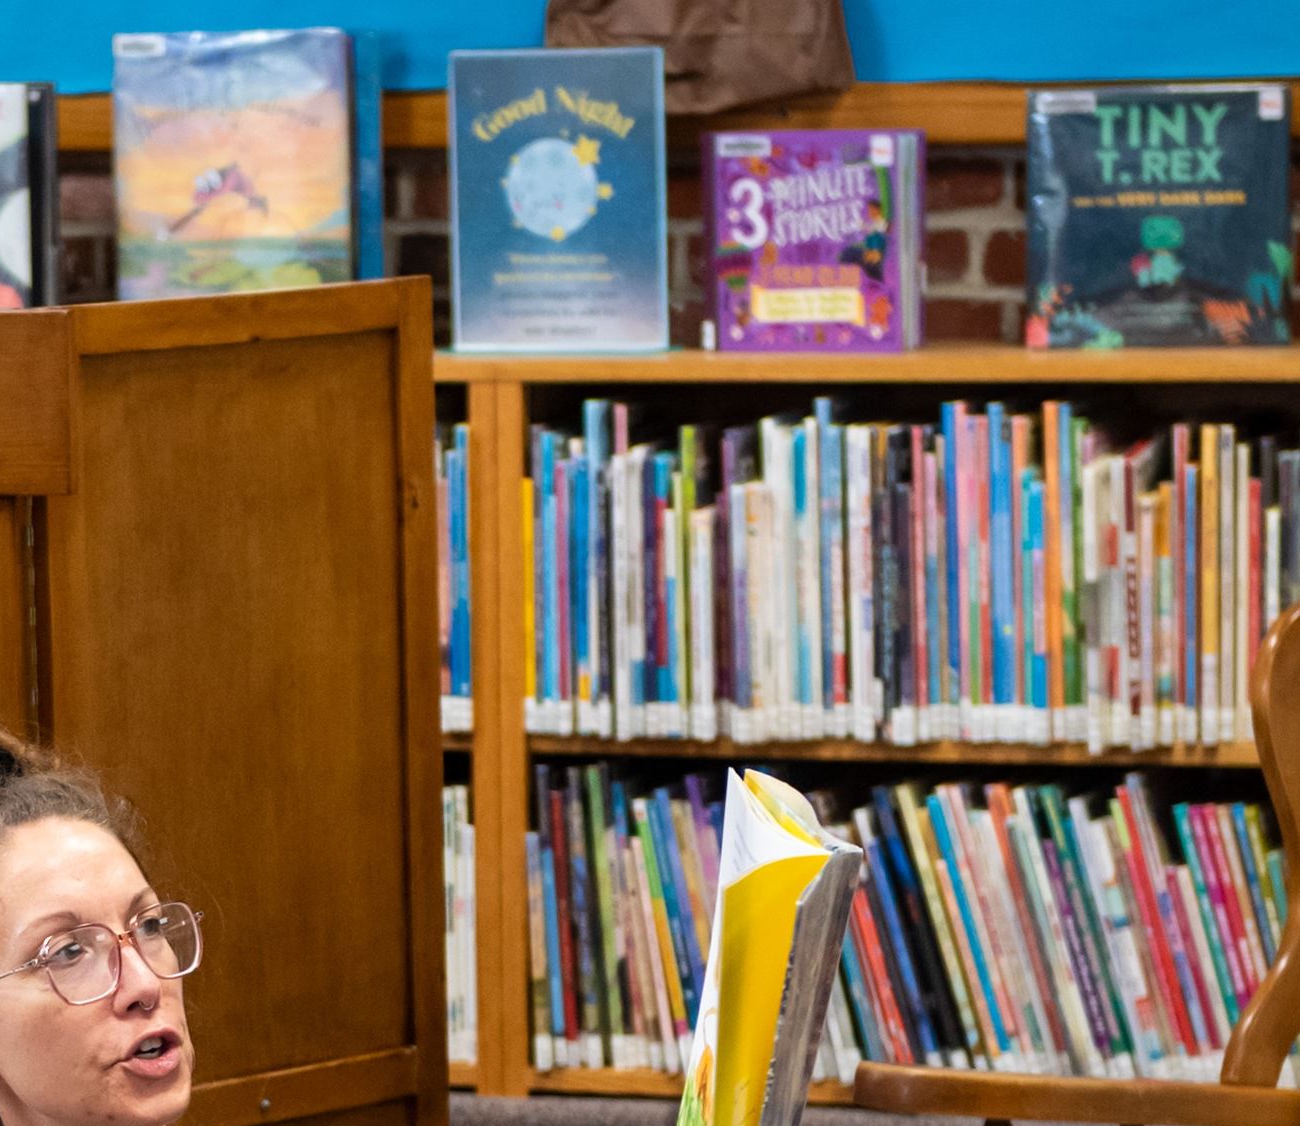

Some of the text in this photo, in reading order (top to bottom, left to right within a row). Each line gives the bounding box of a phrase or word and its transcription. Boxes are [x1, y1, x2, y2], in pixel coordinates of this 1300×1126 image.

[472, 82, 636, 142] Good Night
[1094, 102, 1229, 148] TINY
[1141, 149, 1223, 184] REX
[729, 177, 769, 250] 3
